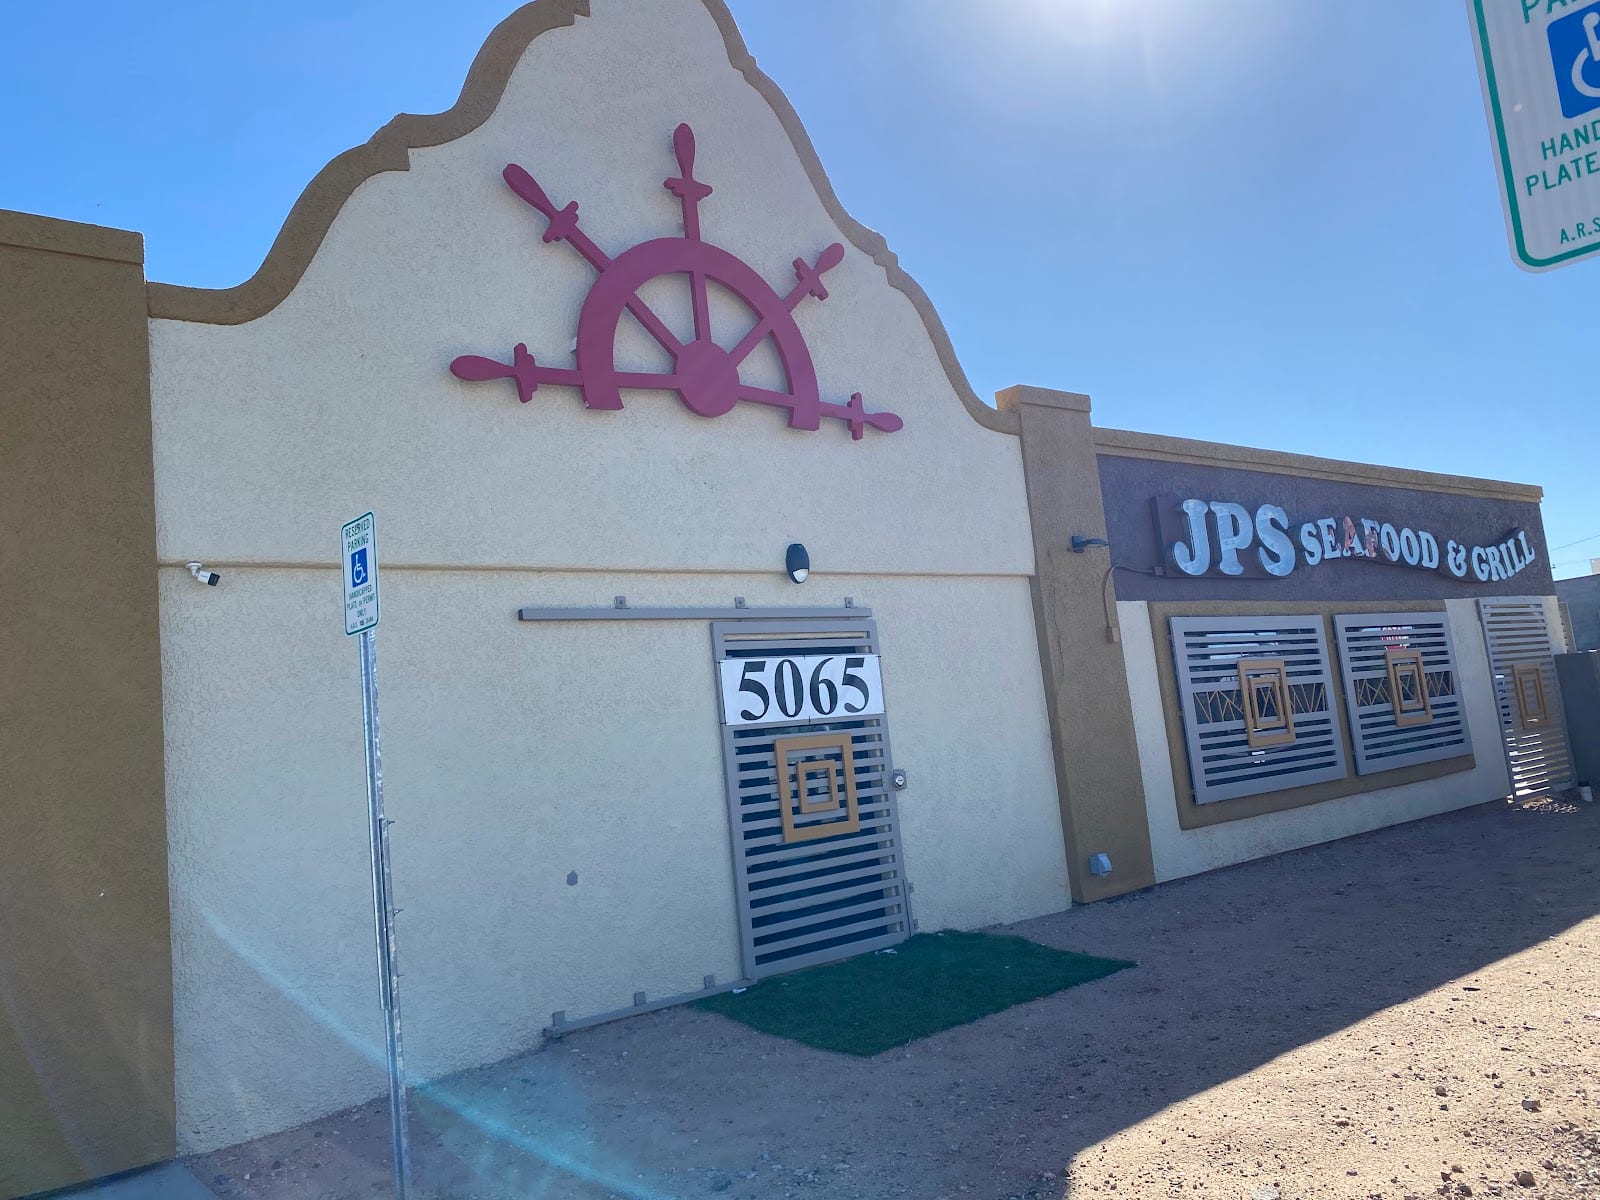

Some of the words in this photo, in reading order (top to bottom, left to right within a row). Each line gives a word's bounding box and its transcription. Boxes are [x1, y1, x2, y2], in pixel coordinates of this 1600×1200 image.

[1541, 120, 1600, 161] HAND
[1525, 151, 1600, 197] PLATE
[345, 518, 371, 540] RESERVED
[347, 533, 369, 553] PARKING
[1173, 499, 1296, 577] JPS
[1300, 516, 1439, 569] SEAFOOD
[1447, 539, 1467, 578] &
[1472, 530, 1536, 583] GRILL
[738, 657, 870, 721] 5065
